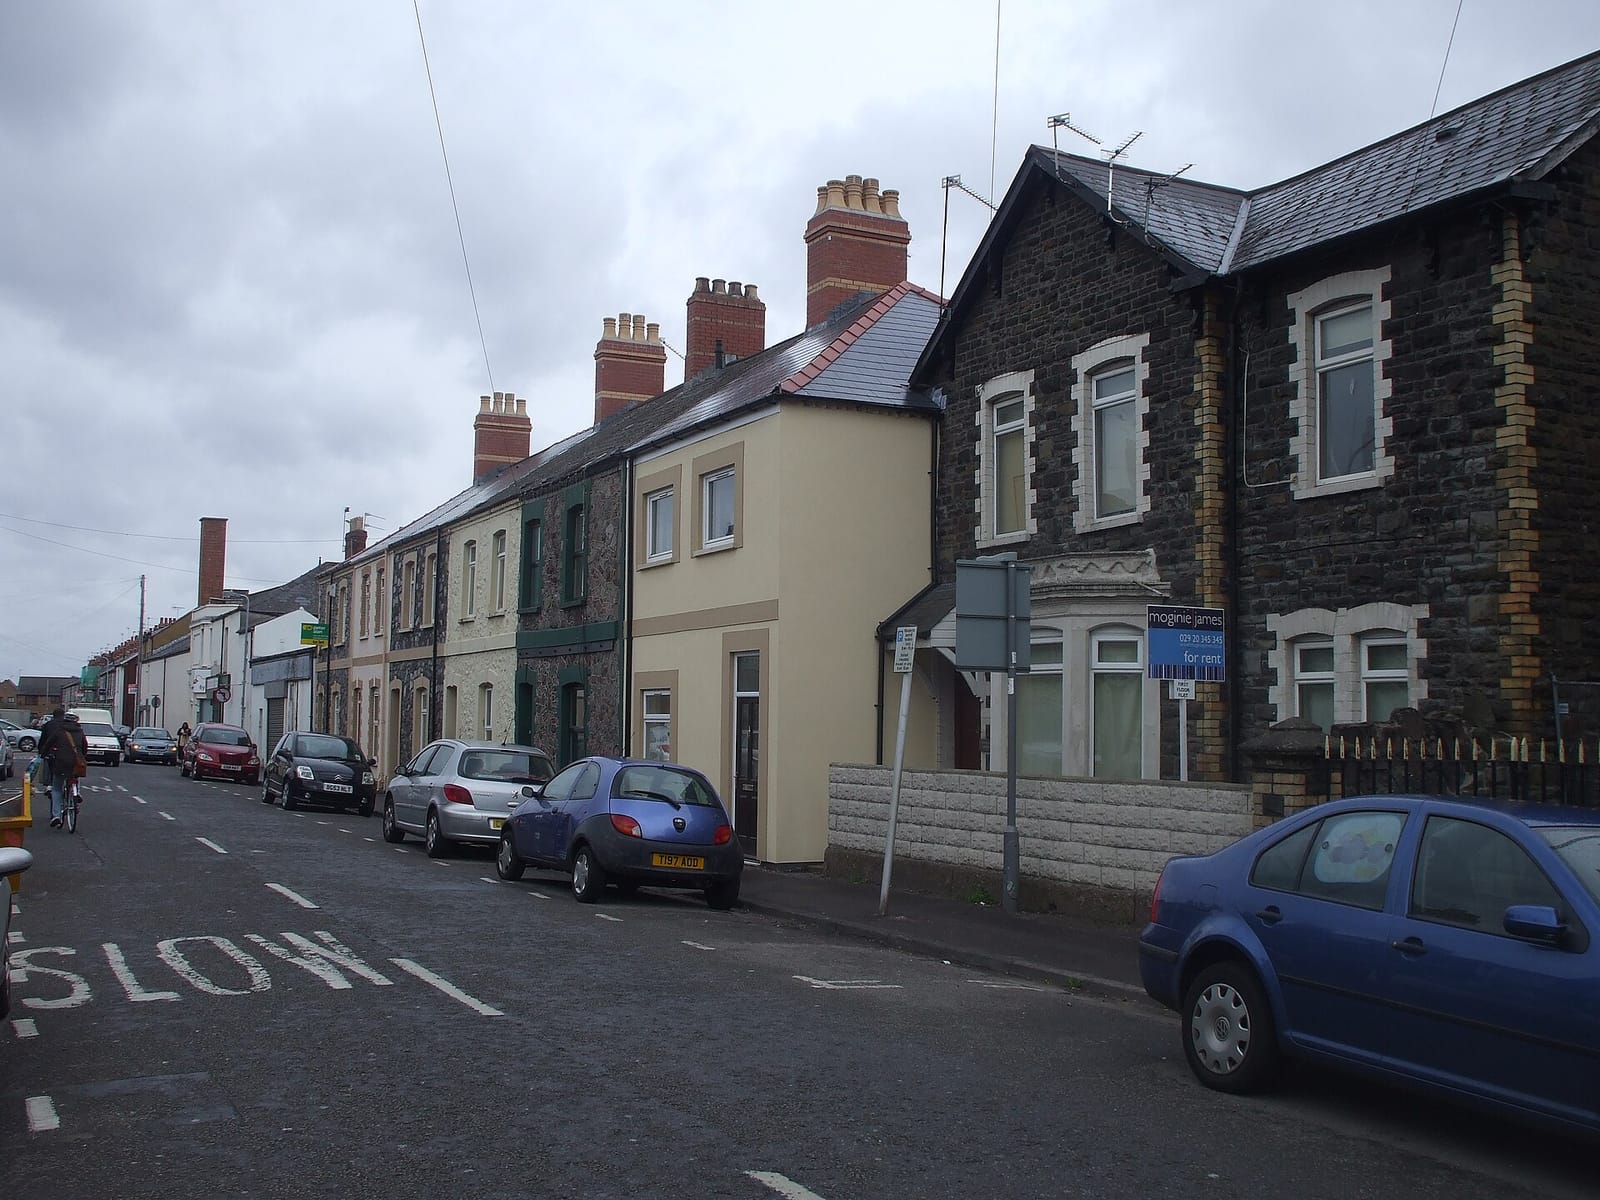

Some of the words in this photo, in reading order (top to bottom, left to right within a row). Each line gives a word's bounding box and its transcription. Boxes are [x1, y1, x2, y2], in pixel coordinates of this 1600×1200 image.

[1149, 610, 1192, 627] moginie
[1194, 611, 1223, 628] james
[1179, 633, 1191, 643] 029
[1192, 634, 1200, 643] 20
[1184, 650, 1199, 663] for
[1201, 654, 1222, 664] rent
[658, 854, 679, 866] T197
[9, 930, 394, 1009] SLOW
